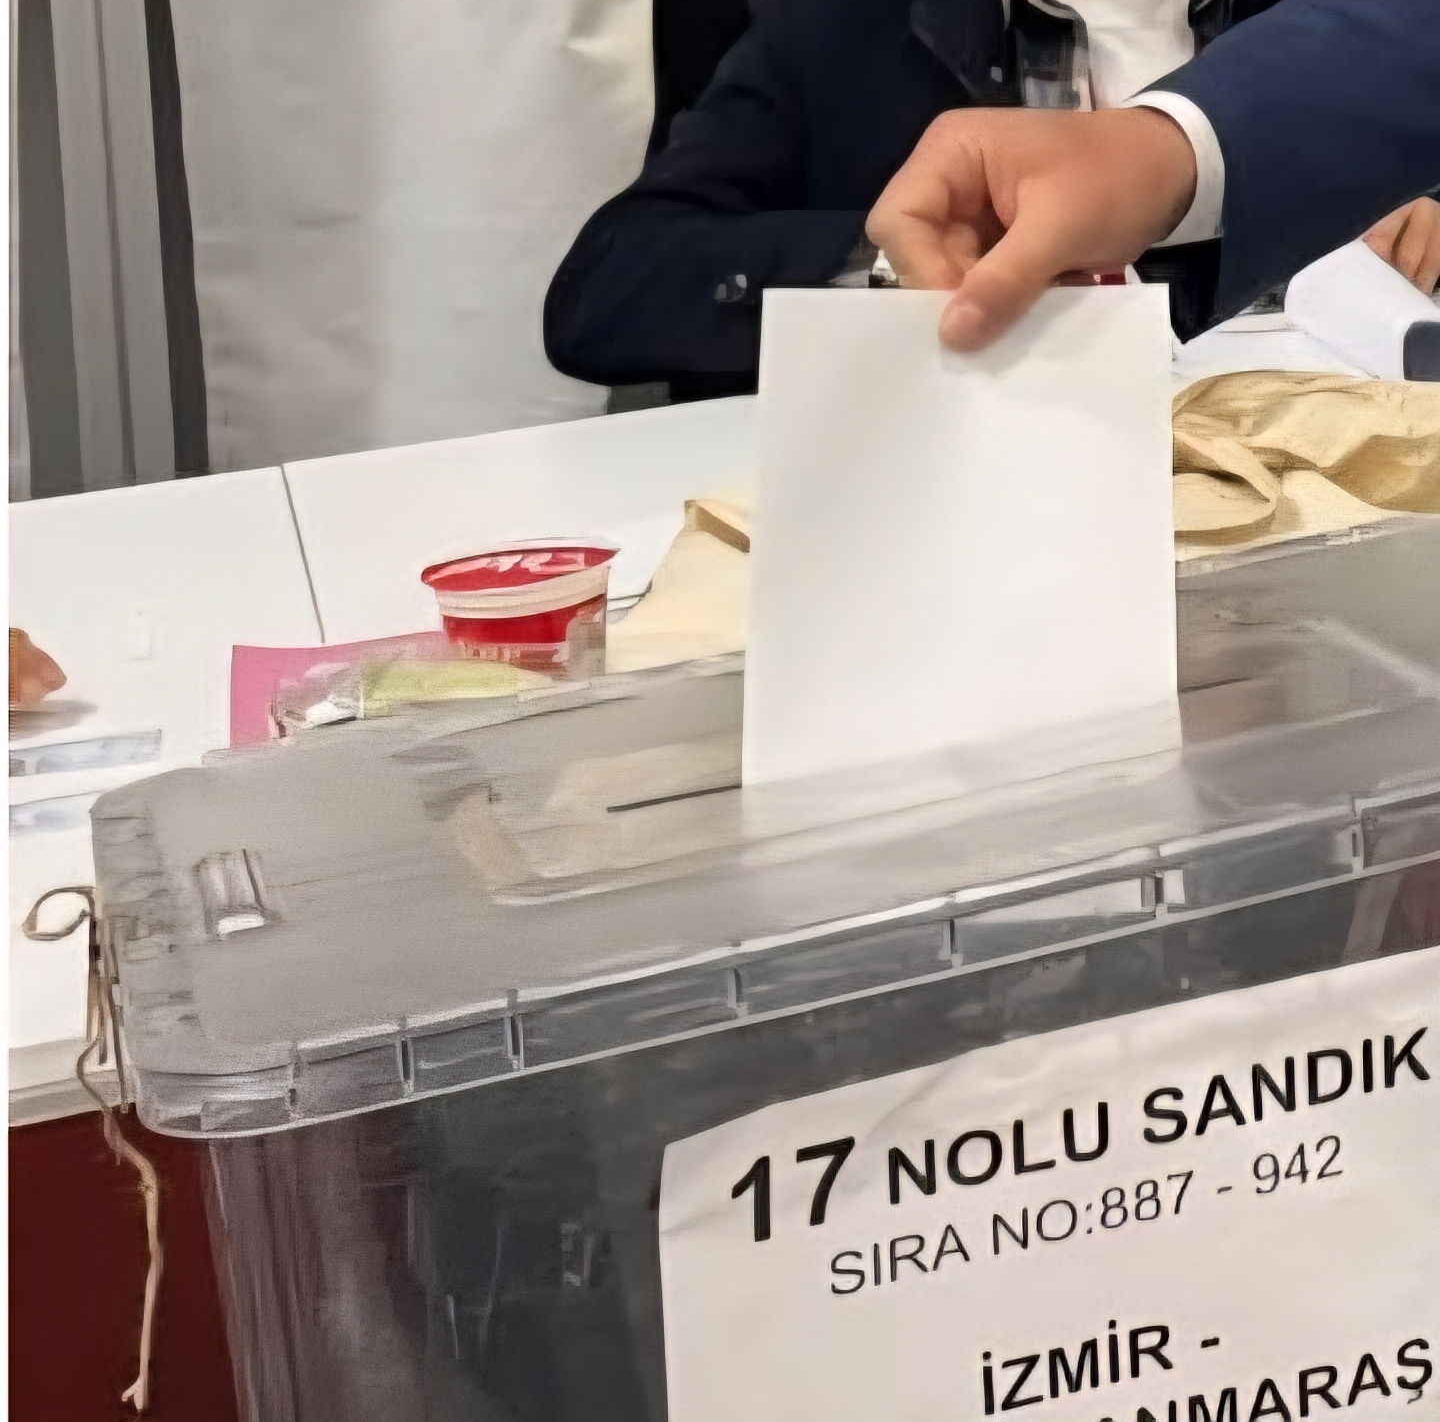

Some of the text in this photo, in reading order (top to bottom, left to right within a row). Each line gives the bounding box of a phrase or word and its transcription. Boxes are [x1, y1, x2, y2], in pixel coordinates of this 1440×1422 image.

[730, 1026, 1431, 1243] 17 NOLU SANDIK
[829, 1223, 971, 1296] SIRA
[992, 1170, 1194, 1257] NO:887
[1252, 1134, 1344, 1196] 942
[982, 1319, 1174, 1416] İZMİR
